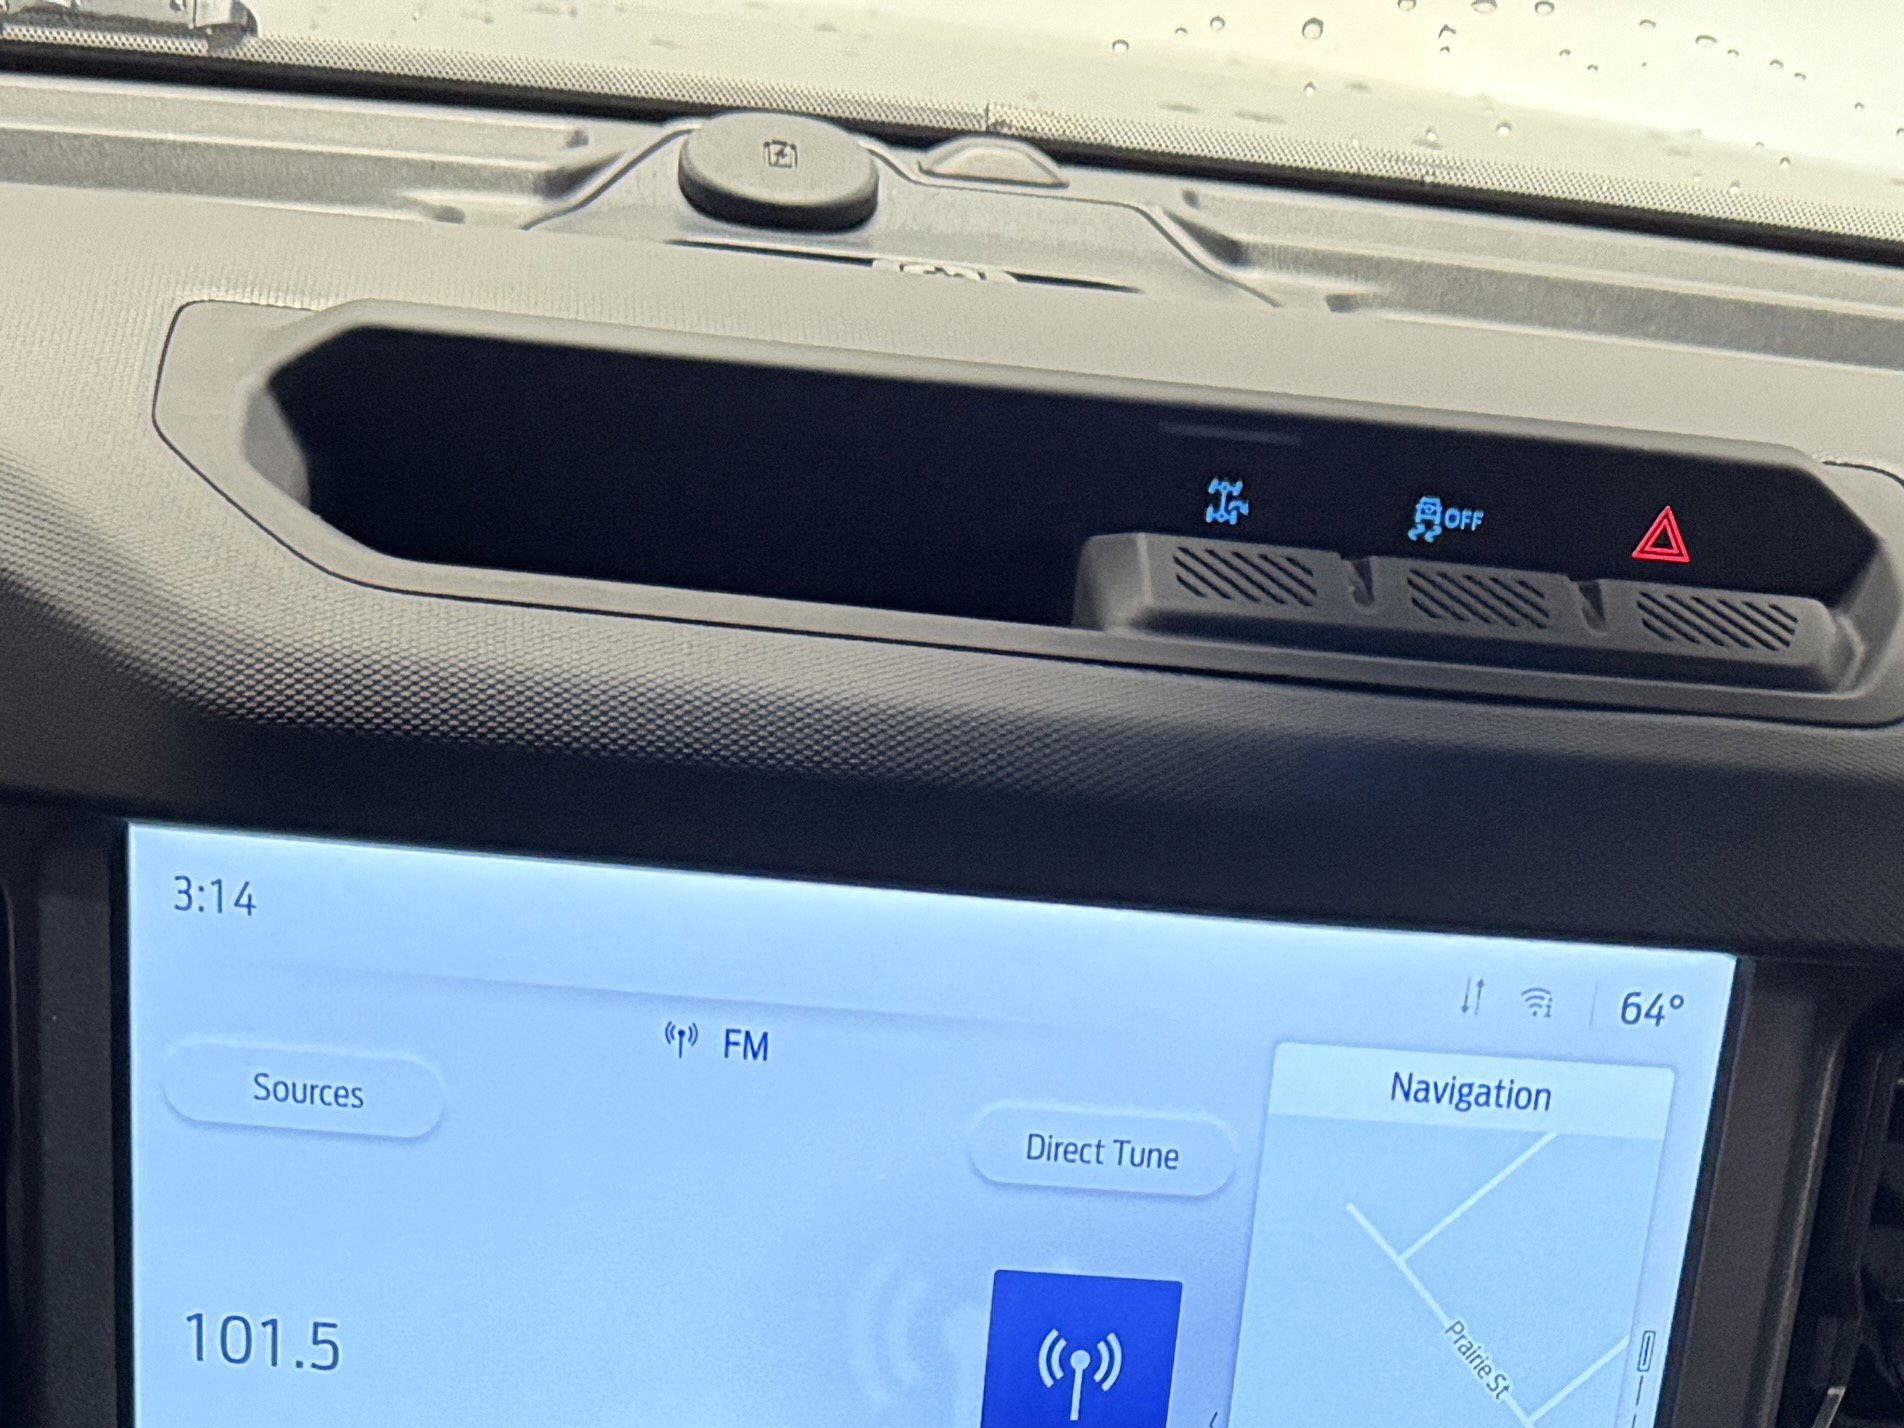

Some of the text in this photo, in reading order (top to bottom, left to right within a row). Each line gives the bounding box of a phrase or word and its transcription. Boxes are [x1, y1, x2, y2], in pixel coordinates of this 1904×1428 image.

[1445, 508, 1484, 532] OFF
[172, 875, 258, 917] 3:14
[1619, 990, 1685, 1028] 64°
[724, 1028, 770, 1062] FM
[252, 1071, 366, 1111] Sources
[1390, 1071, 1553, 1113] Navigation
[1025, 1133, 1181, 1171] Direct Tune
[184, 1311, 342, 1371] 101.5
[1444, 1320, 1511, 1400] Prairie St
